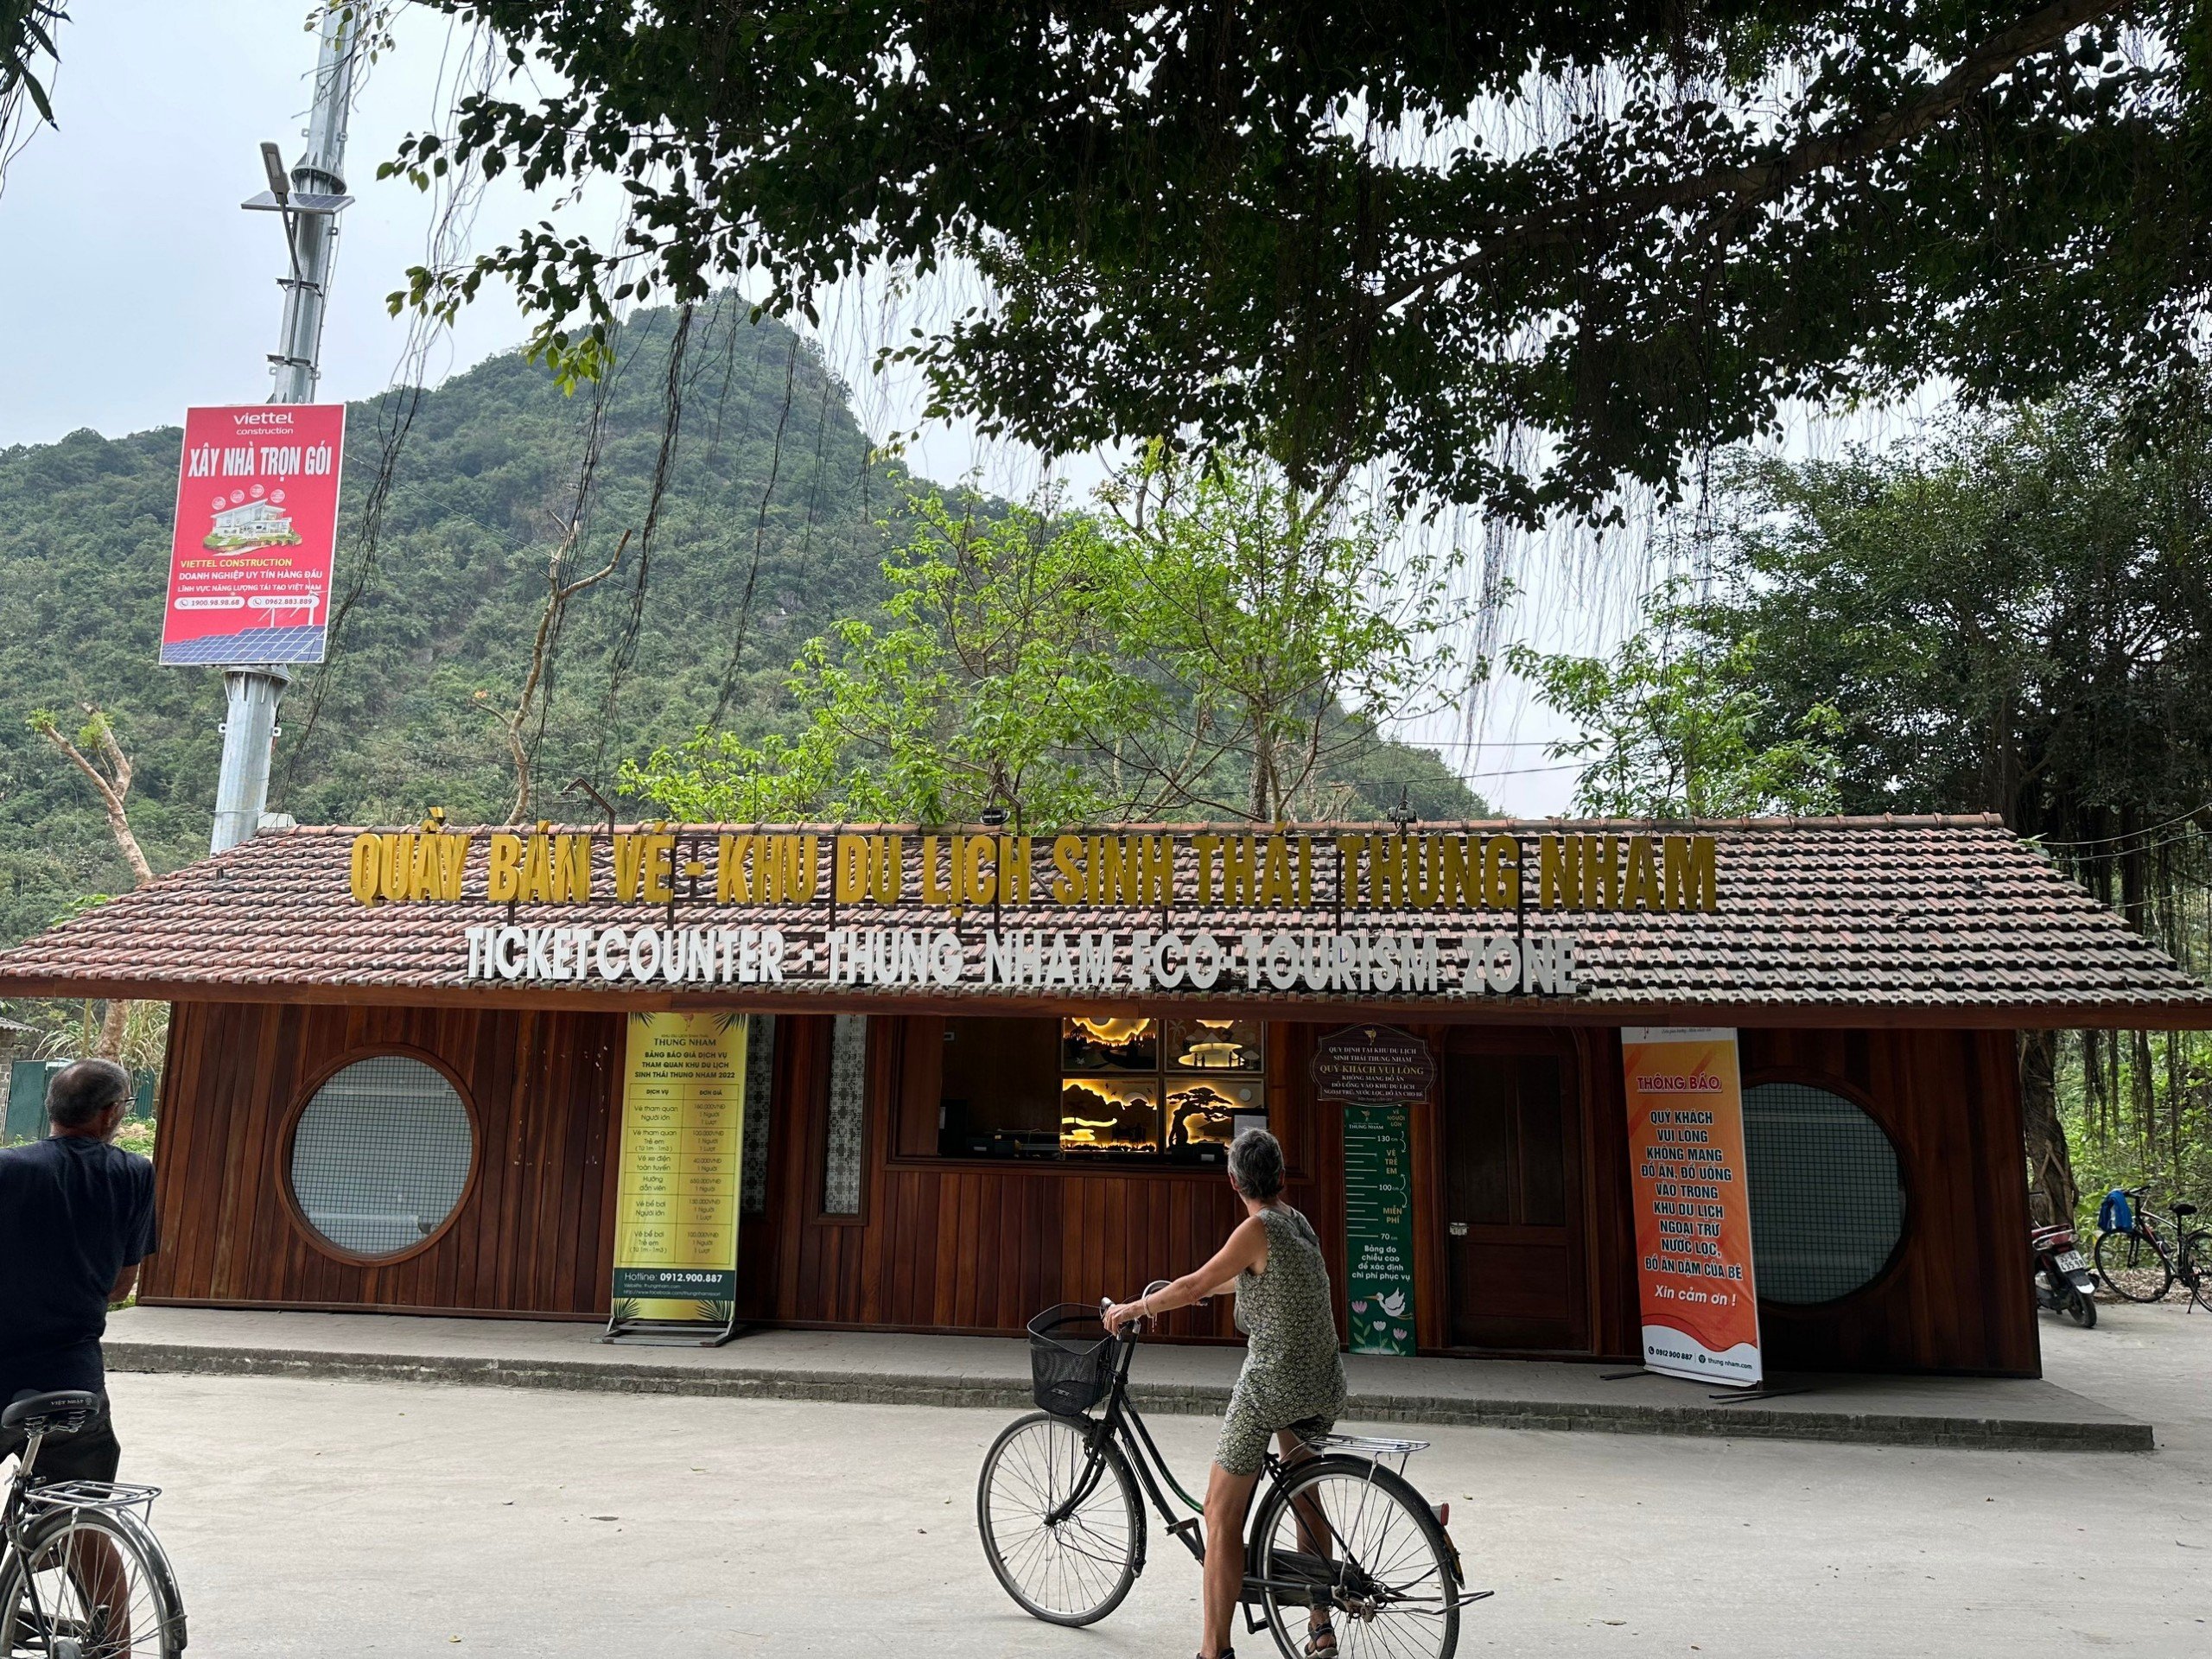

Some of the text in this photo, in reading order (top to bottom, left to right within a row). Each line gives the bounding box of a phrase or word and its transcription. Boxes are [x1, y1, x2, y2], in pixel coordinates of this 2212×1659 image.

[233, 412, 294, 424] viettel
[188, 441, 332, 482] XÂY NHÀ TRỌN GÓI
[219, 558, 292, 567] CONSTRUCTION
[212, 570, 244, 581] NGHIỆP
[260, 569, 275, 578] TÍN
[277, 569, 302, 579] HÀNG
[304, 569, 322, 579] ĐẦU
[351, 806, 472, 909] QUẦY
[487, 820, 591, 902] BÁN
[613, 821, 676, 903] VÉ
[716, 834, 819, 904] KHU
[836, 835, 902, 905] DU
[923, 835, 1031, 918] LỊCH
[1052, 834, 1174, 906] SINH
[1191, 821, 1312, 907] THÁI
[1336, 835, 1520, 908] THUNG
[1540, 835, 1717, 911] NHAM
[825, 930, 964, 986] THUNG
[984, 930, 1115, 988] NHAM
[1462, 936, 1577, 994] ZONE
[654, 1038, 686, 1046] THUNG
[1319, 1064, 1339, 1073] QUÝ
[1343, 1063, 1376, 1073] KHÁCH
[1397, 1065, 1424, 1075] LÒNG
[1637, 1072, 1722, 1090] THÔNG BÁO
[1649, 1108, 1713, 1125] QUÝ KHÁCH
[1657, 1127, 1708, 1143] VUI LÒNG
[1646, 1145, 1723, 1162] KHÔNG MANG
[1658, 1163, 1678, 1179] ĂN,
[1699, 1162, 1732, 1182] UỐNG
[1655, 1180, 1719, 1199] VÀO TRONG
[1653, 1201, 1725, 1222] KHU DU LỊCH
[1659, 1220, 1720, 1238] NGOẠI TRỪ
[1364, 1244, 1383, 1254] Bảng
[1661, 1237, 1722, 1259] NƯỚC LỌC,
[1380, 1273, 1399, 1281] phục
[1387, 1264, 1403, 1273] định
[1661, 1258, 1675, 1273] ĂN
[1678, 1259, 1701, 1278] DẶM
[1704, 1259, 1726, 1278] CỦA
[1727, 1263, 1743, 1280] BÉ
[625, 1273, 722, 1282] Hotline: 0912.900.887
[1655, 1284, 1675, 1300] Xin
[1678, 1287, 1707, 1303] cảm
[1711, 1293, 1728, 1306] ơn
